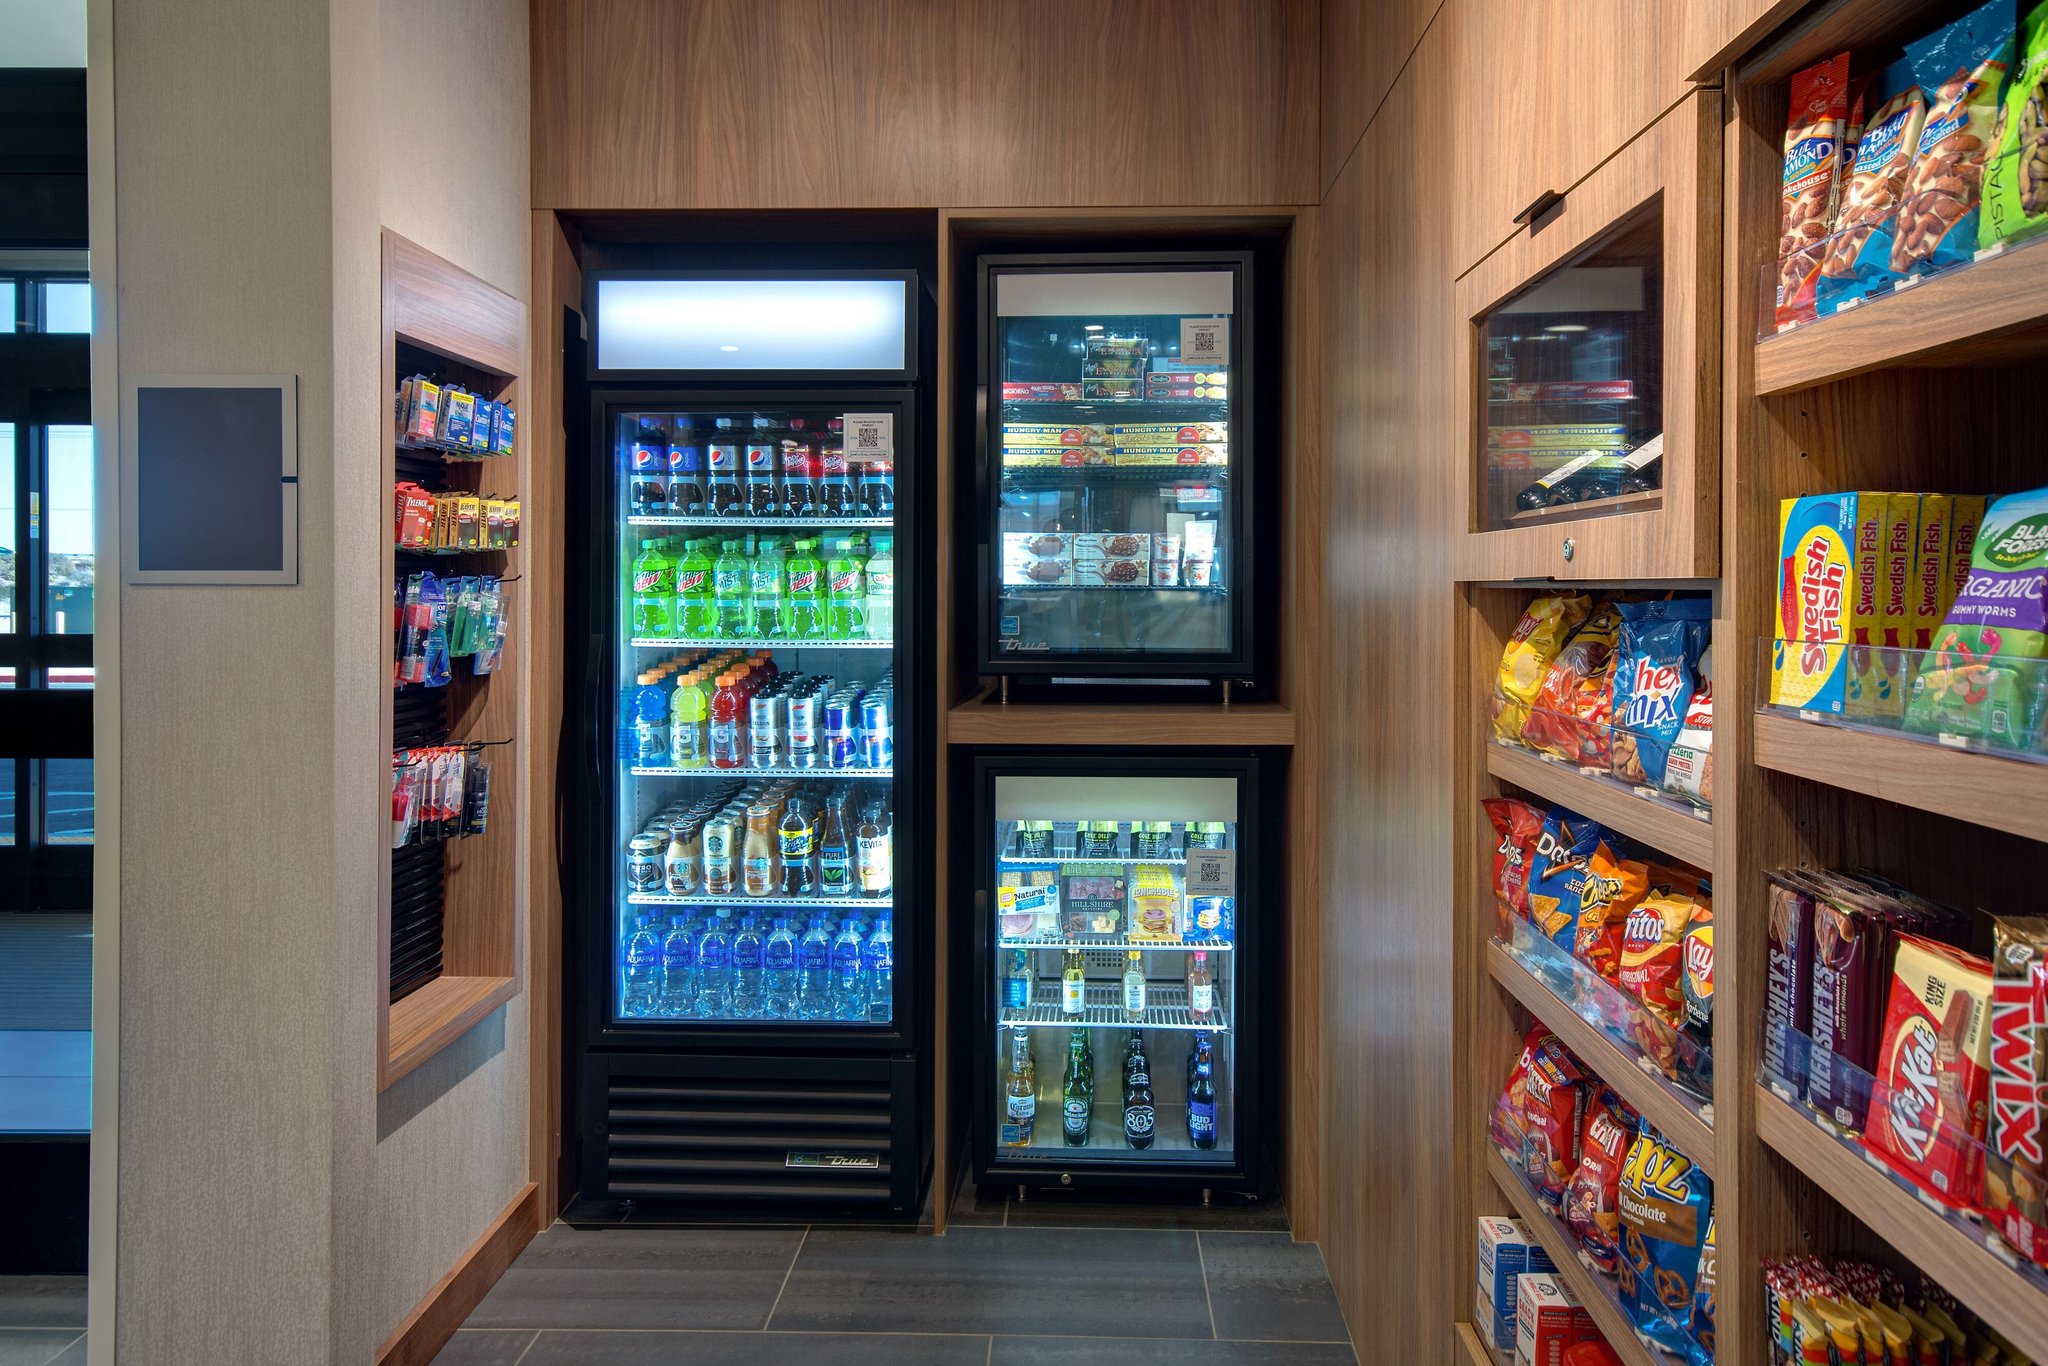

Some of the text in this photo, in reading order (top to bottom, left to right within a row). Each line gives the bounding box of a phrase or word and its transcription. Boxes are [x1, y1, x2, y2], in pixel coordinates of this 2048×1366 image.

[1784, 142, 1834, 177] AMOND
[1786, 139, 1811, 161] BLUE
[1783, 171, 1828, 196] okehouse
[397, 494, 406, 523] TYLENOL
[407, 497, 428, 507] TYLENOL
[1955, 524, 1974, 556] Fish
[2011, 524, 2048, 540] BLA
[1856, 520, 1879, 617] Swedish Fish
[1886, 521, 1909, 618] Swedish Fish
[1918, 522, 1943, 618] Swedish Fish
[719, 574, 738, 589] MIST
[1960, 576, 2047, 600] RGANIC
[1801, 536, 1830, 676] Swedish
[1819, 562, 1846, 644] Fish
[1952, 605, 2017, 618] GUMMY WORMS
[998, 638, 1050, 650] true
[1634, 655, 1684, 692] hex
[1657, 722, 1678, 731] SNACK
[860, 840, 882, 849] KEVITA
[1014, 887, 1045, 901] Natural
[1624, 910, 1664, 944] ritos
[662, 955, 689, 964] AQUAFINA
[834, 958, 862, 967] AQUAFINA
[871, 958, 892, 967] AQUAFIN
[1688, 936, 1713, 981] Lay
[1924, 975, 1938, 1006] KING
[1934, 980, 1946, 1008] SIZE
[1836, 1012, 1846, 1040] whole
[1010, 1102, 1033, 1111] Corona
[1192, 1114, 1210, 1123] BUD
[1127, 1112, 1154, 1128] 805
[1190, 1120, 1213, 1131] LIGHT
[1623, 1196, 1666, 1224] Chocolate
[1770, 1291, 1782, 1345] KIND
